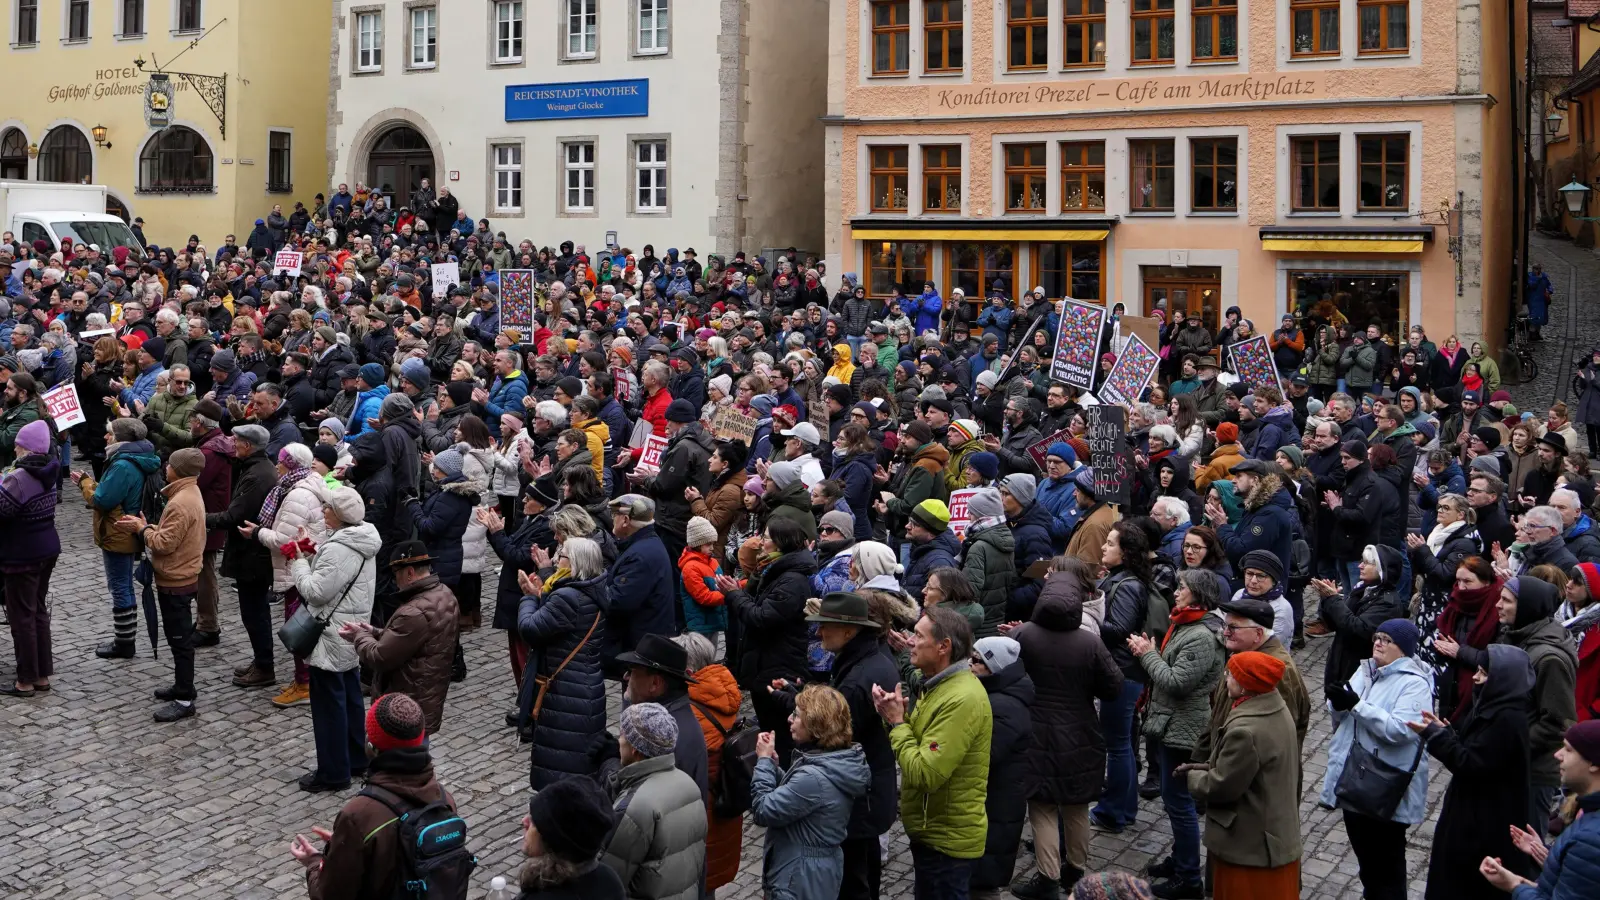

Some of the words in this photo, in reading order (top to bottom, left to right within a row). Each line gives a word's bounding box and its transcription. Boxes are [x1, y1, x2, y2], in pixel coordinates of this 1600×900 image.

[95, 67, 139, 80] HOTEL
[514, 86, 638, 101] REICHSSTADT-VINOTHEK
[938, 86, 1031, 109] Konditorei
[1034, 83, 1095, 103] Prezel
[1116, 81, 1158, 103] Café
[1163, 85, 1191, 98] am
[1198, 76, 1315, 101] Marktplatz
[547, 102, 576, 112] Weingut
[577, 102, 604, 110] Glocke
[1055, 360, 1092, 377] GEMEINSAM
[1055, 369, 1087, 385] VIELFÄLTIG
[1089, 439, 1115, 453] RECHTE
[644, 449, 662, 464] JET
[1091, 453, 1117, 469] GEGEN
[1094, 471, 1120, 496] NAZIS
[951, 504, 969, 518] JETZ
